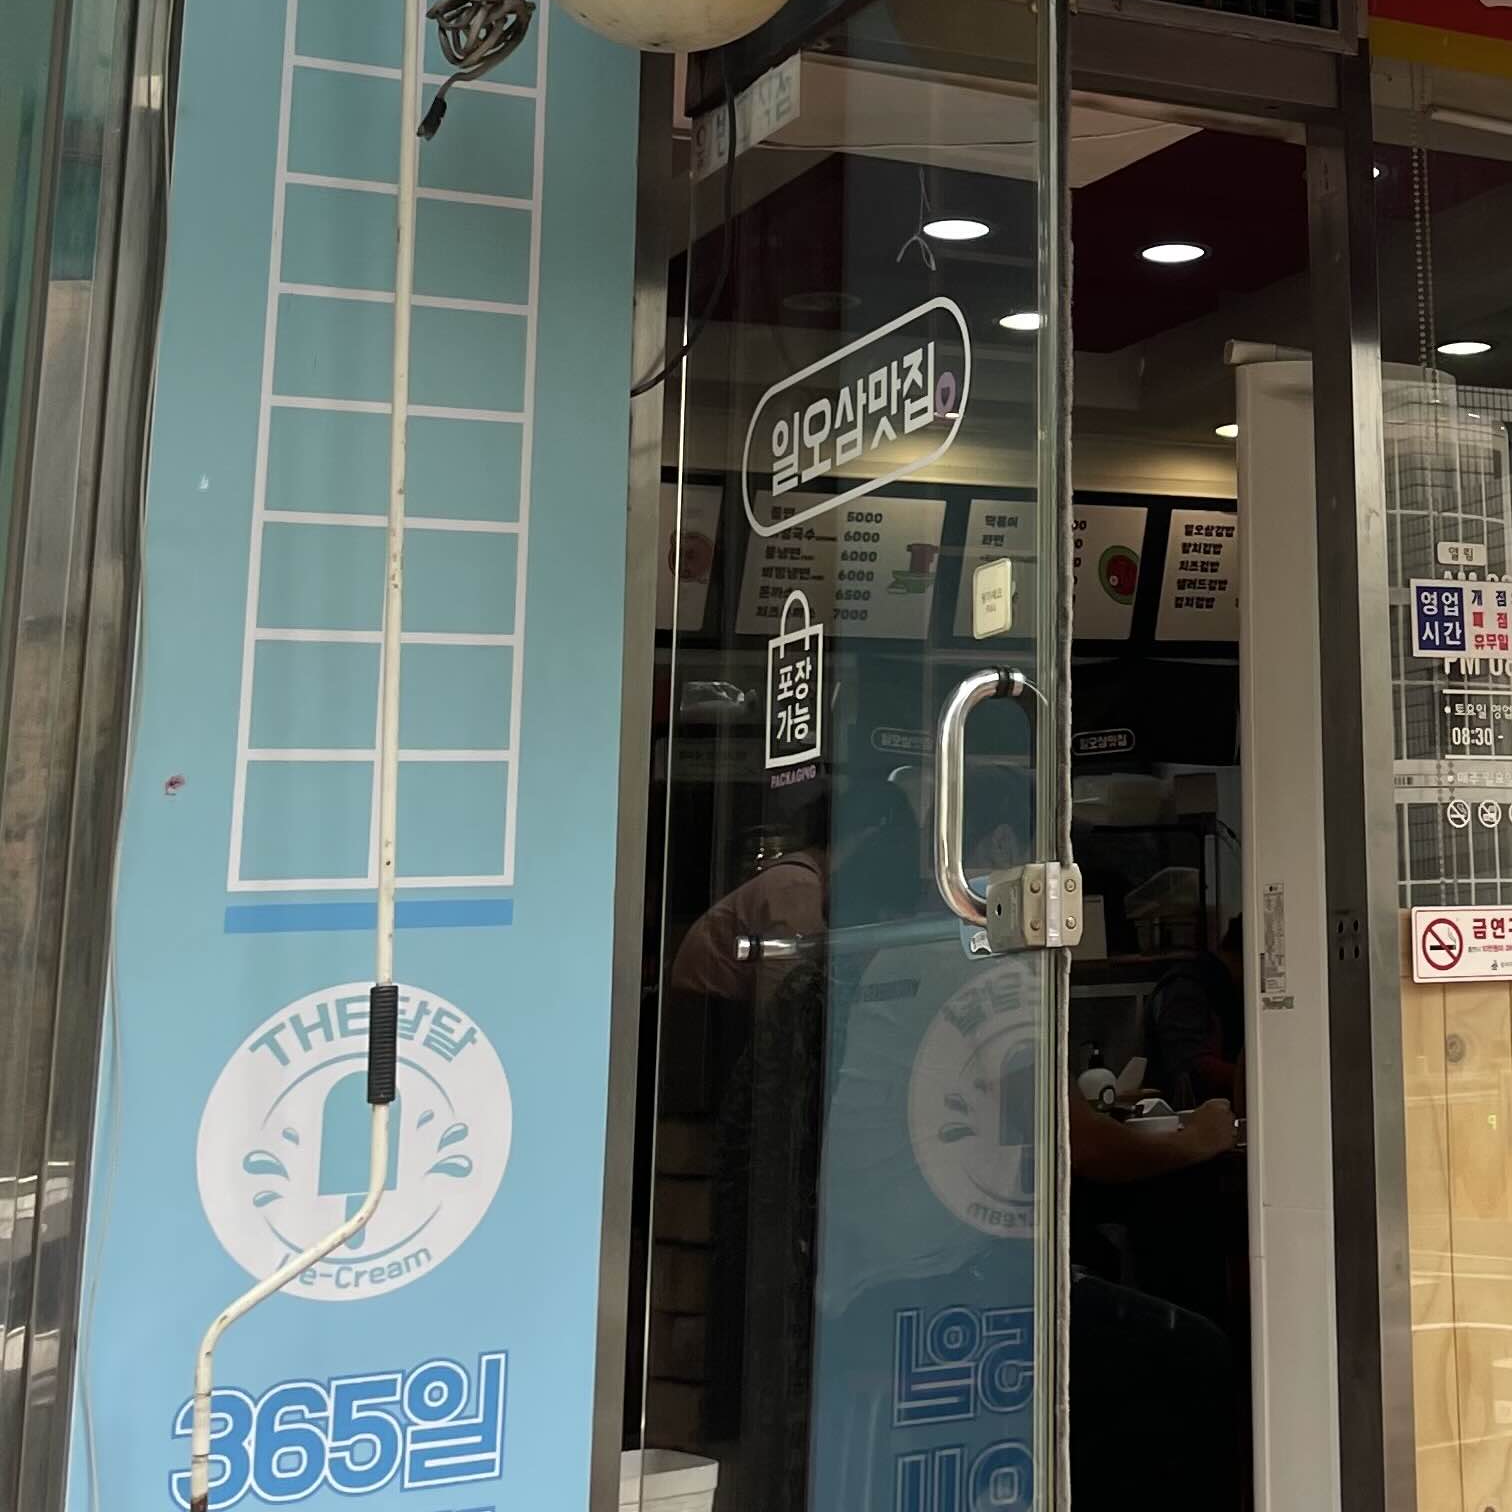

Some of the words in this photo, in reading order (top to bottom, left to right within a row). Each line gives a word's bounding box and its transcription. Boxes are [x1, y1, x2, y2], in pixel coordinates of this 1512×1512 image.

[772, 341, 935, 496] 일오삼맛집
[847, 512, 883, 523] 5000
[844, 531, 880, 543] 6000
[841, 550, 877, 562] 6000
[1421, 591, 1459, 616] 영업
[1422, 622, 1462, 646] 시간
[778, 656, 812, 701] 포장
[776, 703, 811, 743] 가능
[167, 1349, 509, 1511] 365일
